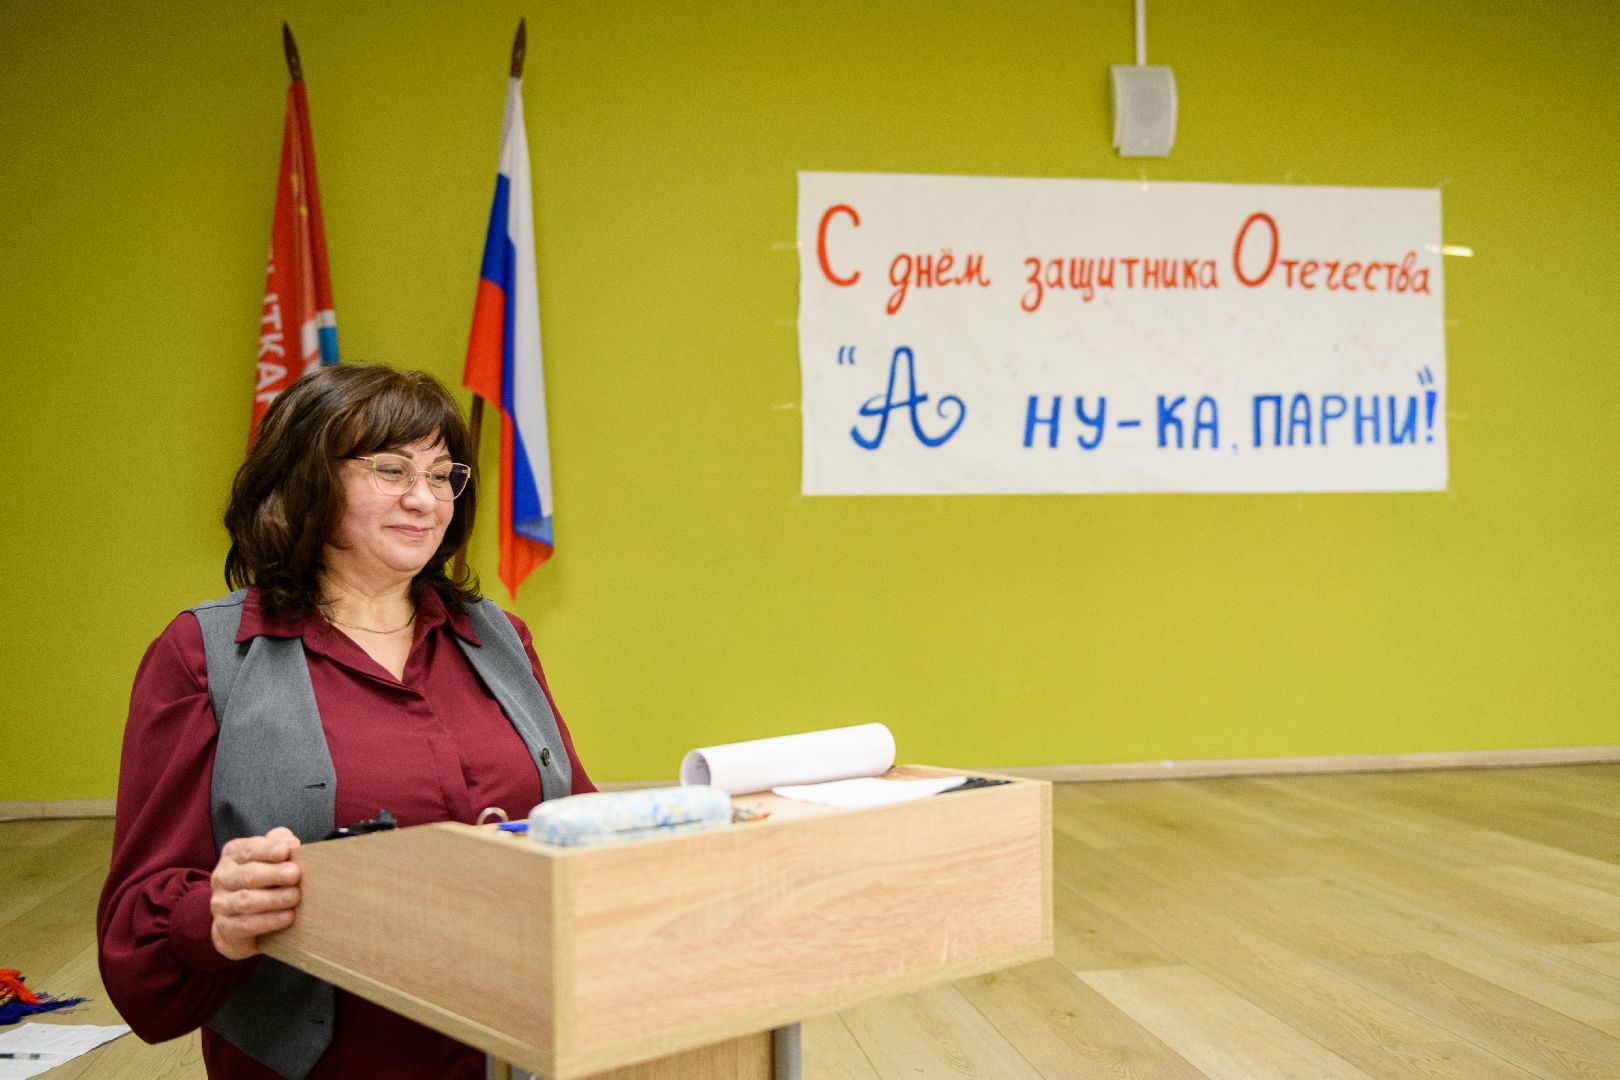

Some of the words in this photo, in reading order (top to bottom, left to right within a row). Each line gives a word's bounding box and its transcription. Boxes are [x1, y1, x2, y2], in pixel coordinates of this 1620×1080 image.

[816, 203, 861, 288] С
[885, 249, 991, 316] днём
[1020, 256, 1219, 313] защитника
[1232, 211, 1430, 294] Отечества
